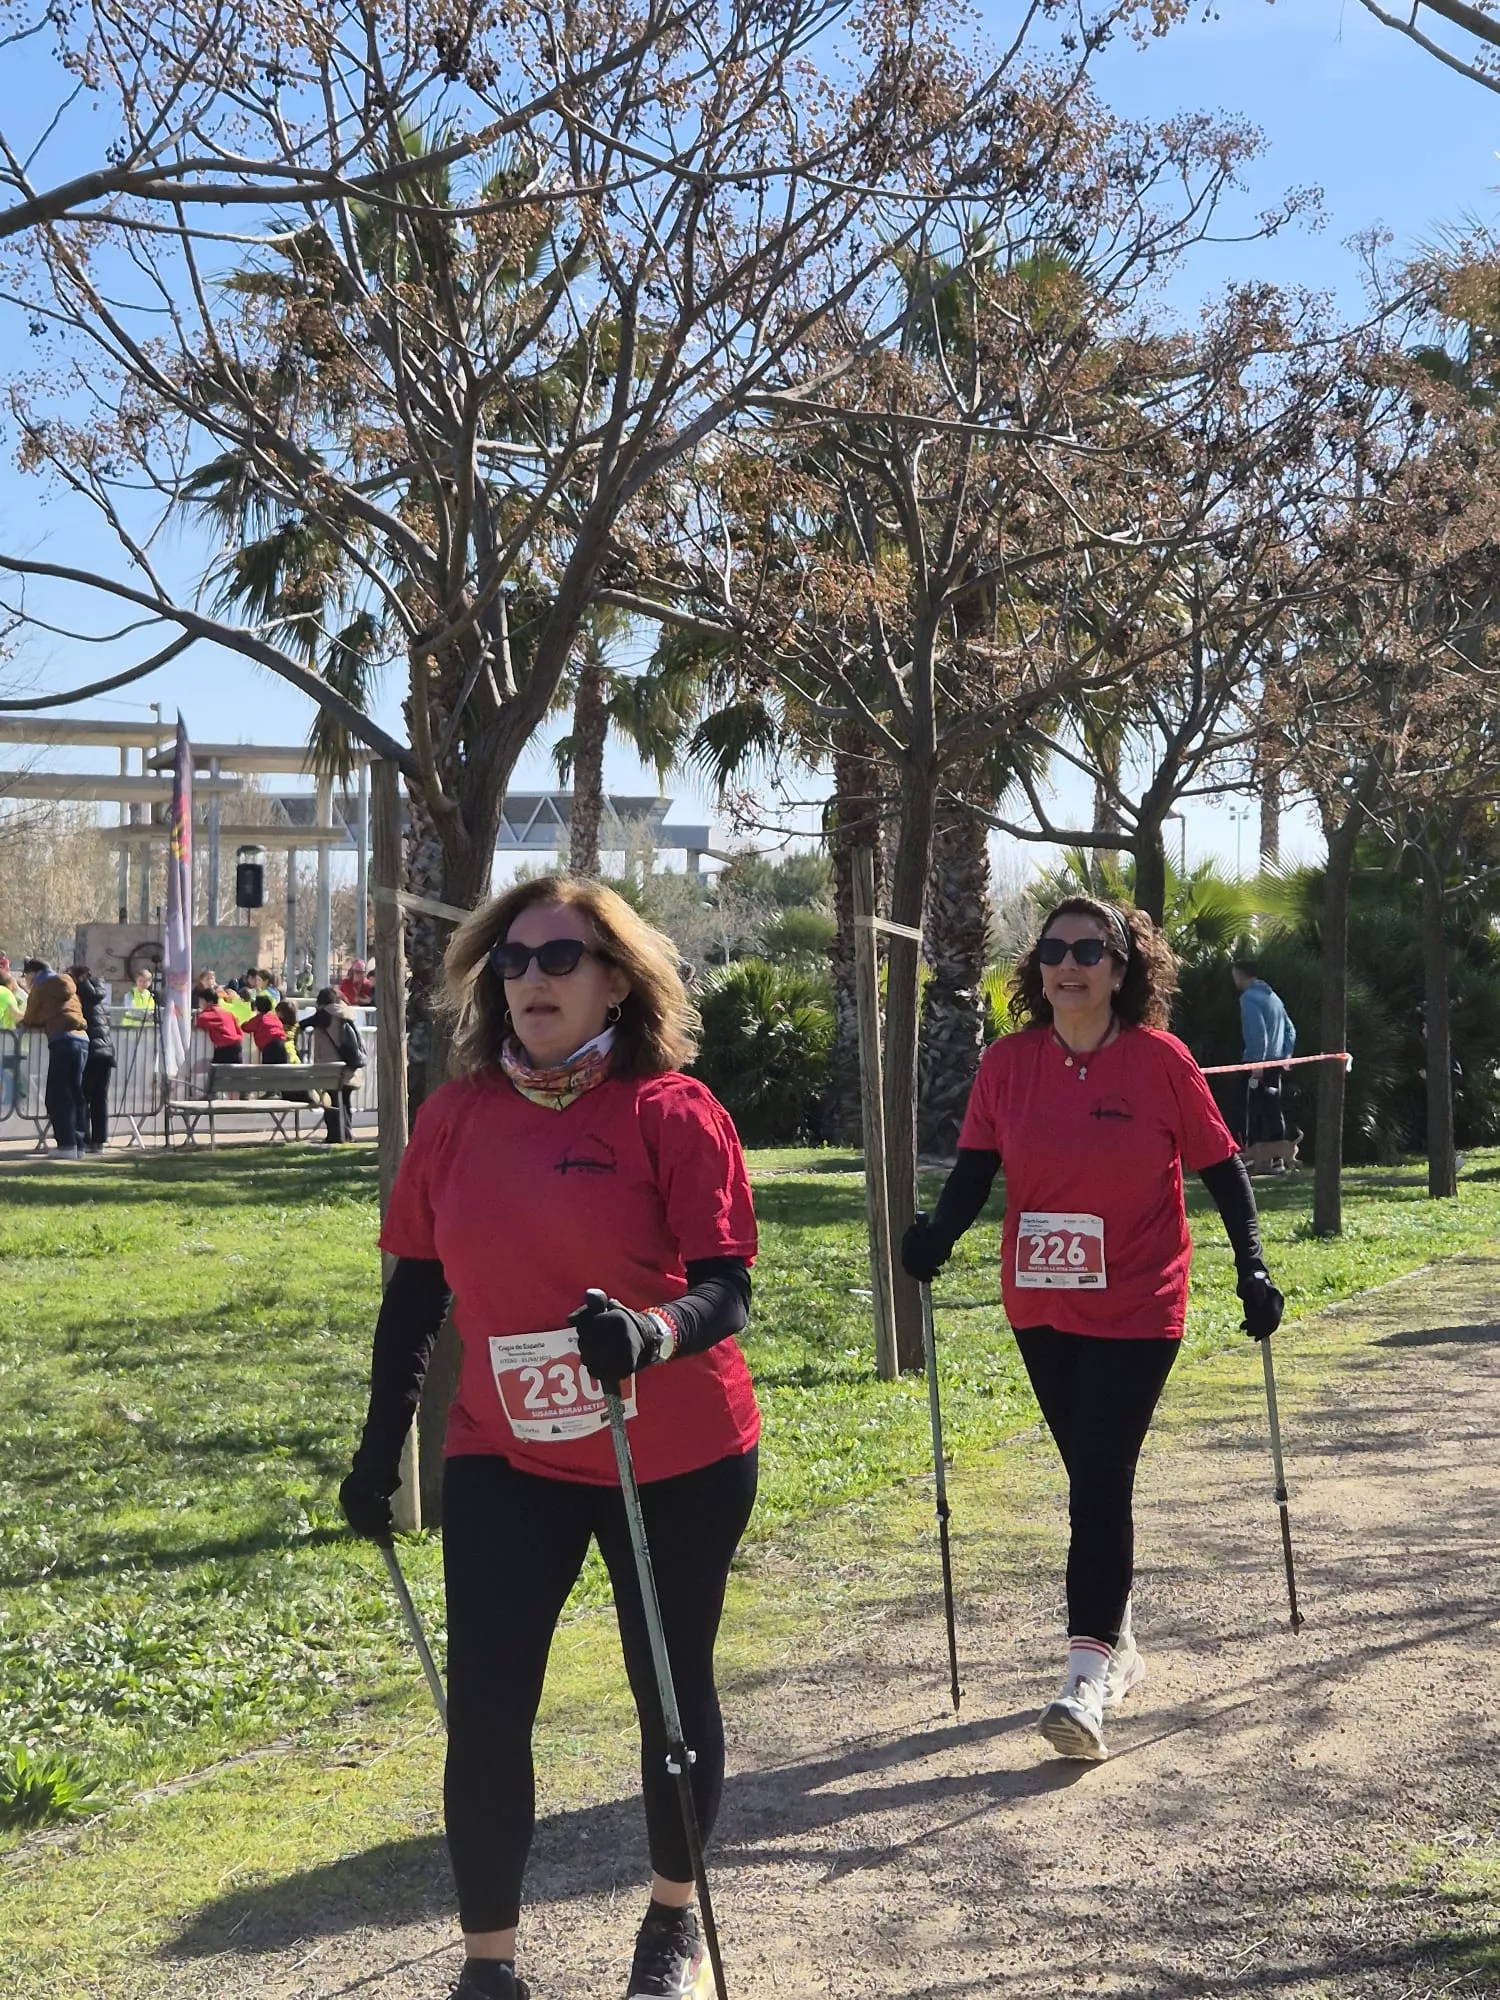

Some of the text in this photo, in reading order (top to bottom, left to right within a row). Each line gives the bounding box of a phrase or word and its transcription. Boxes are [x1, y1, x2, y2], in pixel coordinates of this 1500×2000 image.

[1029, 1236, 1086, 1266] 226
[523, 1342, 545, 1351] España
[520, 1364, 604, 1409] 230
